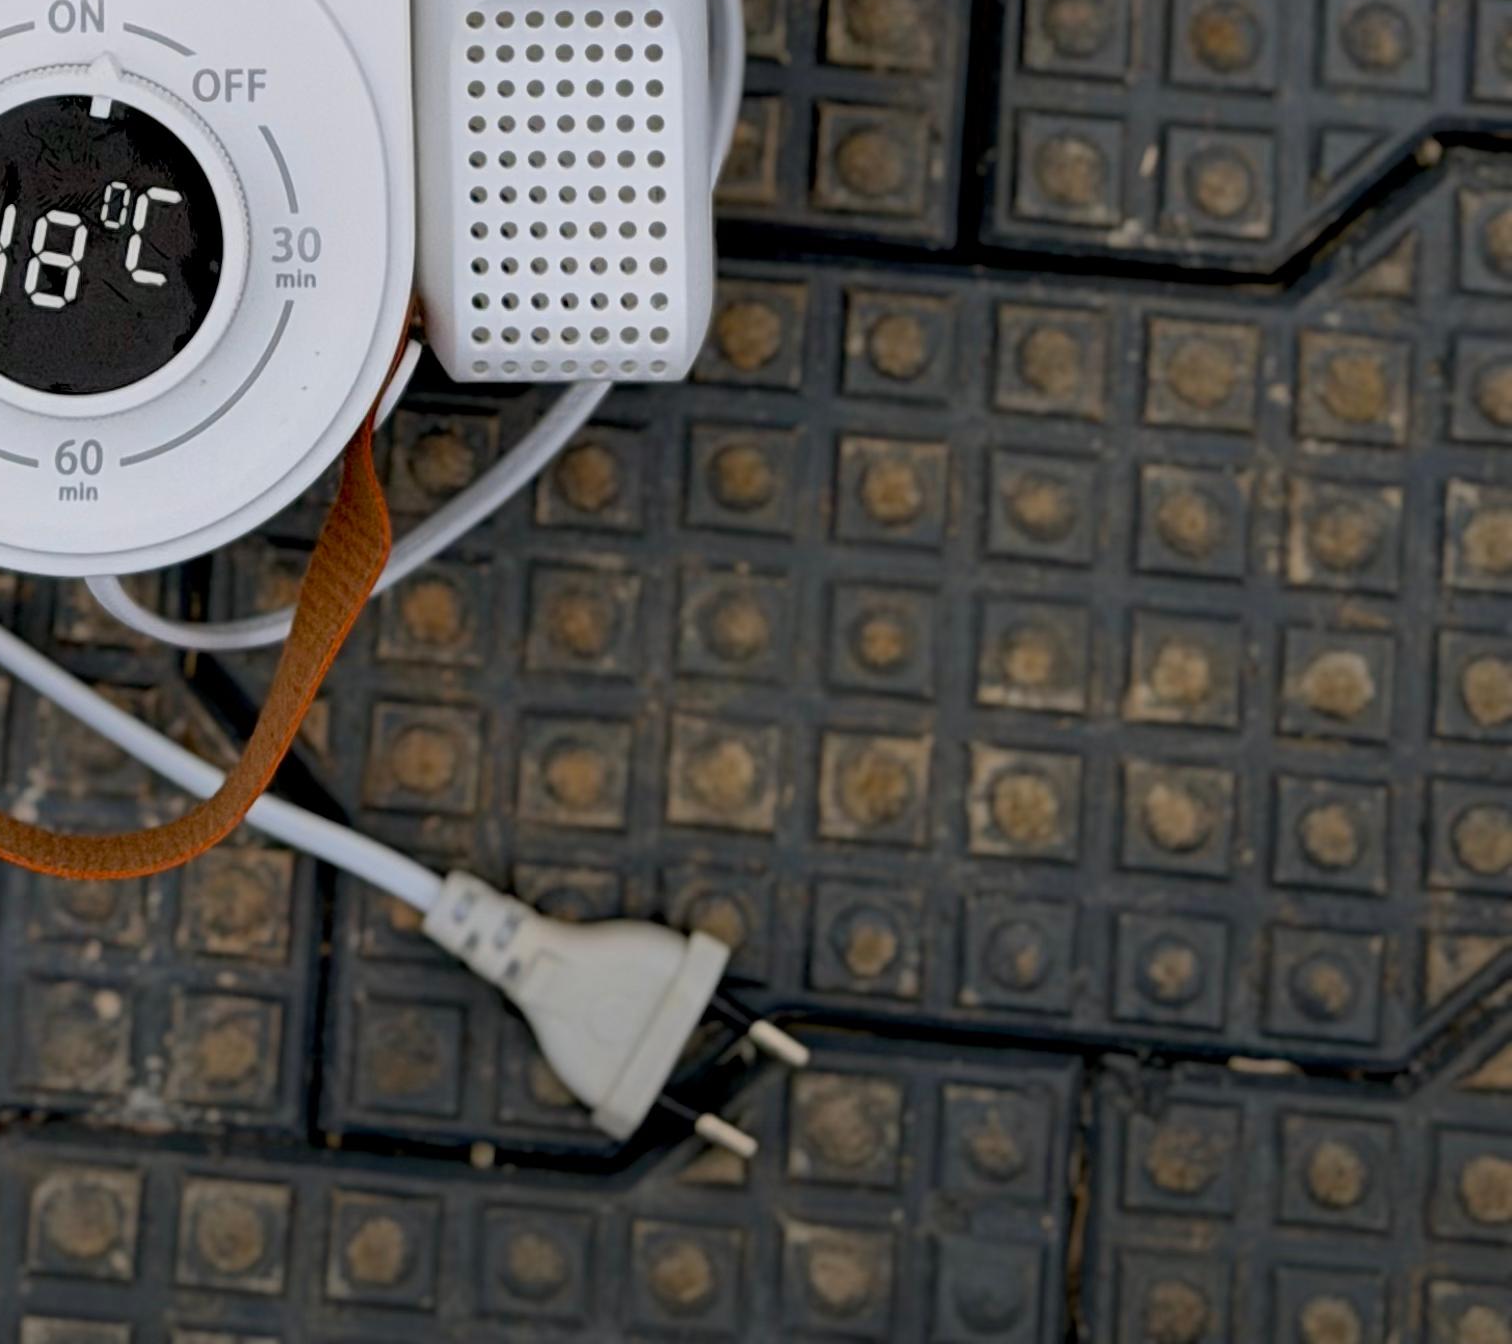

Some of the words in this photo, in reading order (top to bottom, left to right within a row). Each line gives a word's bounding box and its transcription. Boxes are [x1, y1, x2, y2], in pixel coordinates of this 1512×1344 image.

[48, 0, 105, 33] ON
[193, 69, 267, 103] OFF
[271, 227, 321, 263] 30
[275, 269, 317, 289] min
[53, 439, 103, 475] 60
[58, 481, 99, 502] min
